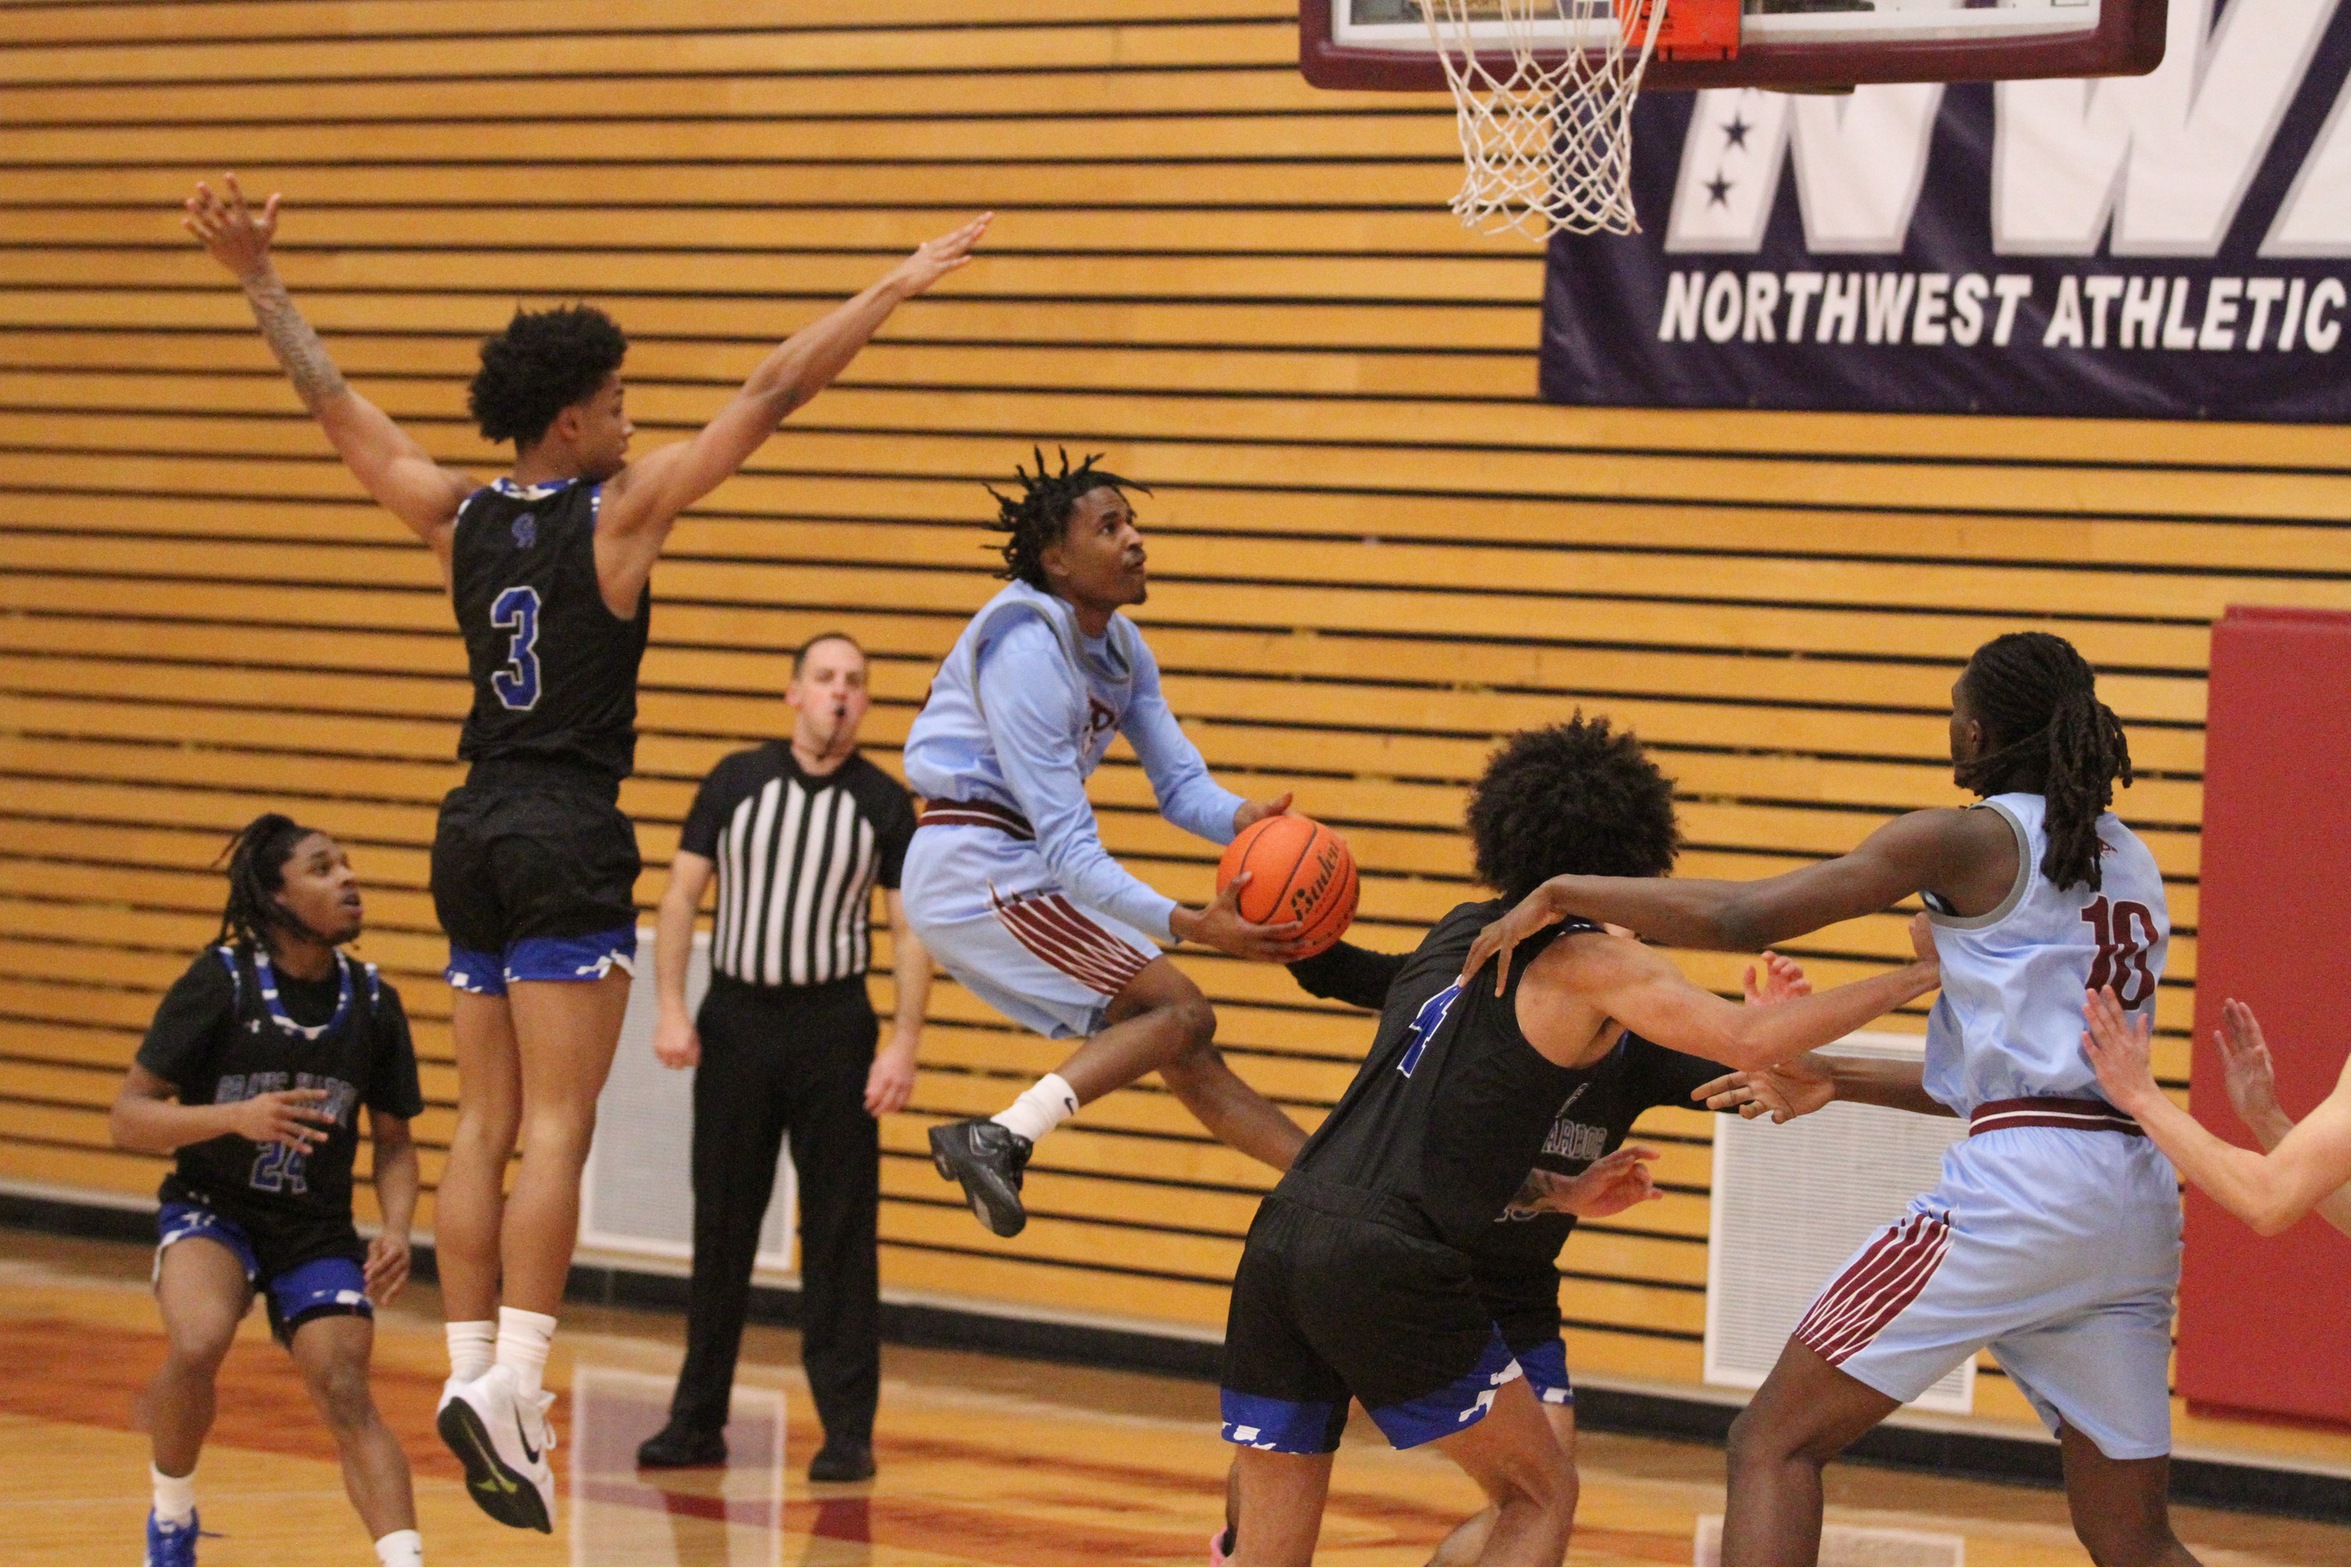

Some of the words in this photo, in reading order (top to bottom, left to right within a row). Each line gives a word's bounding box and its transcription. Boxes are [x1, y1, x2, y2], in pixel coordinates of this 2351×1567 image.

[1658, 271, 2033, 347] NORTHWEST
[2042, 275, 2347, 354] ATHLETIC
[490, 585, 541, 710] 3
[2080, 895, 2159, 1011] 10
[249, 1136, 309, 1195] 24
[1541, 1118, 1608, 1161] ARBOR
